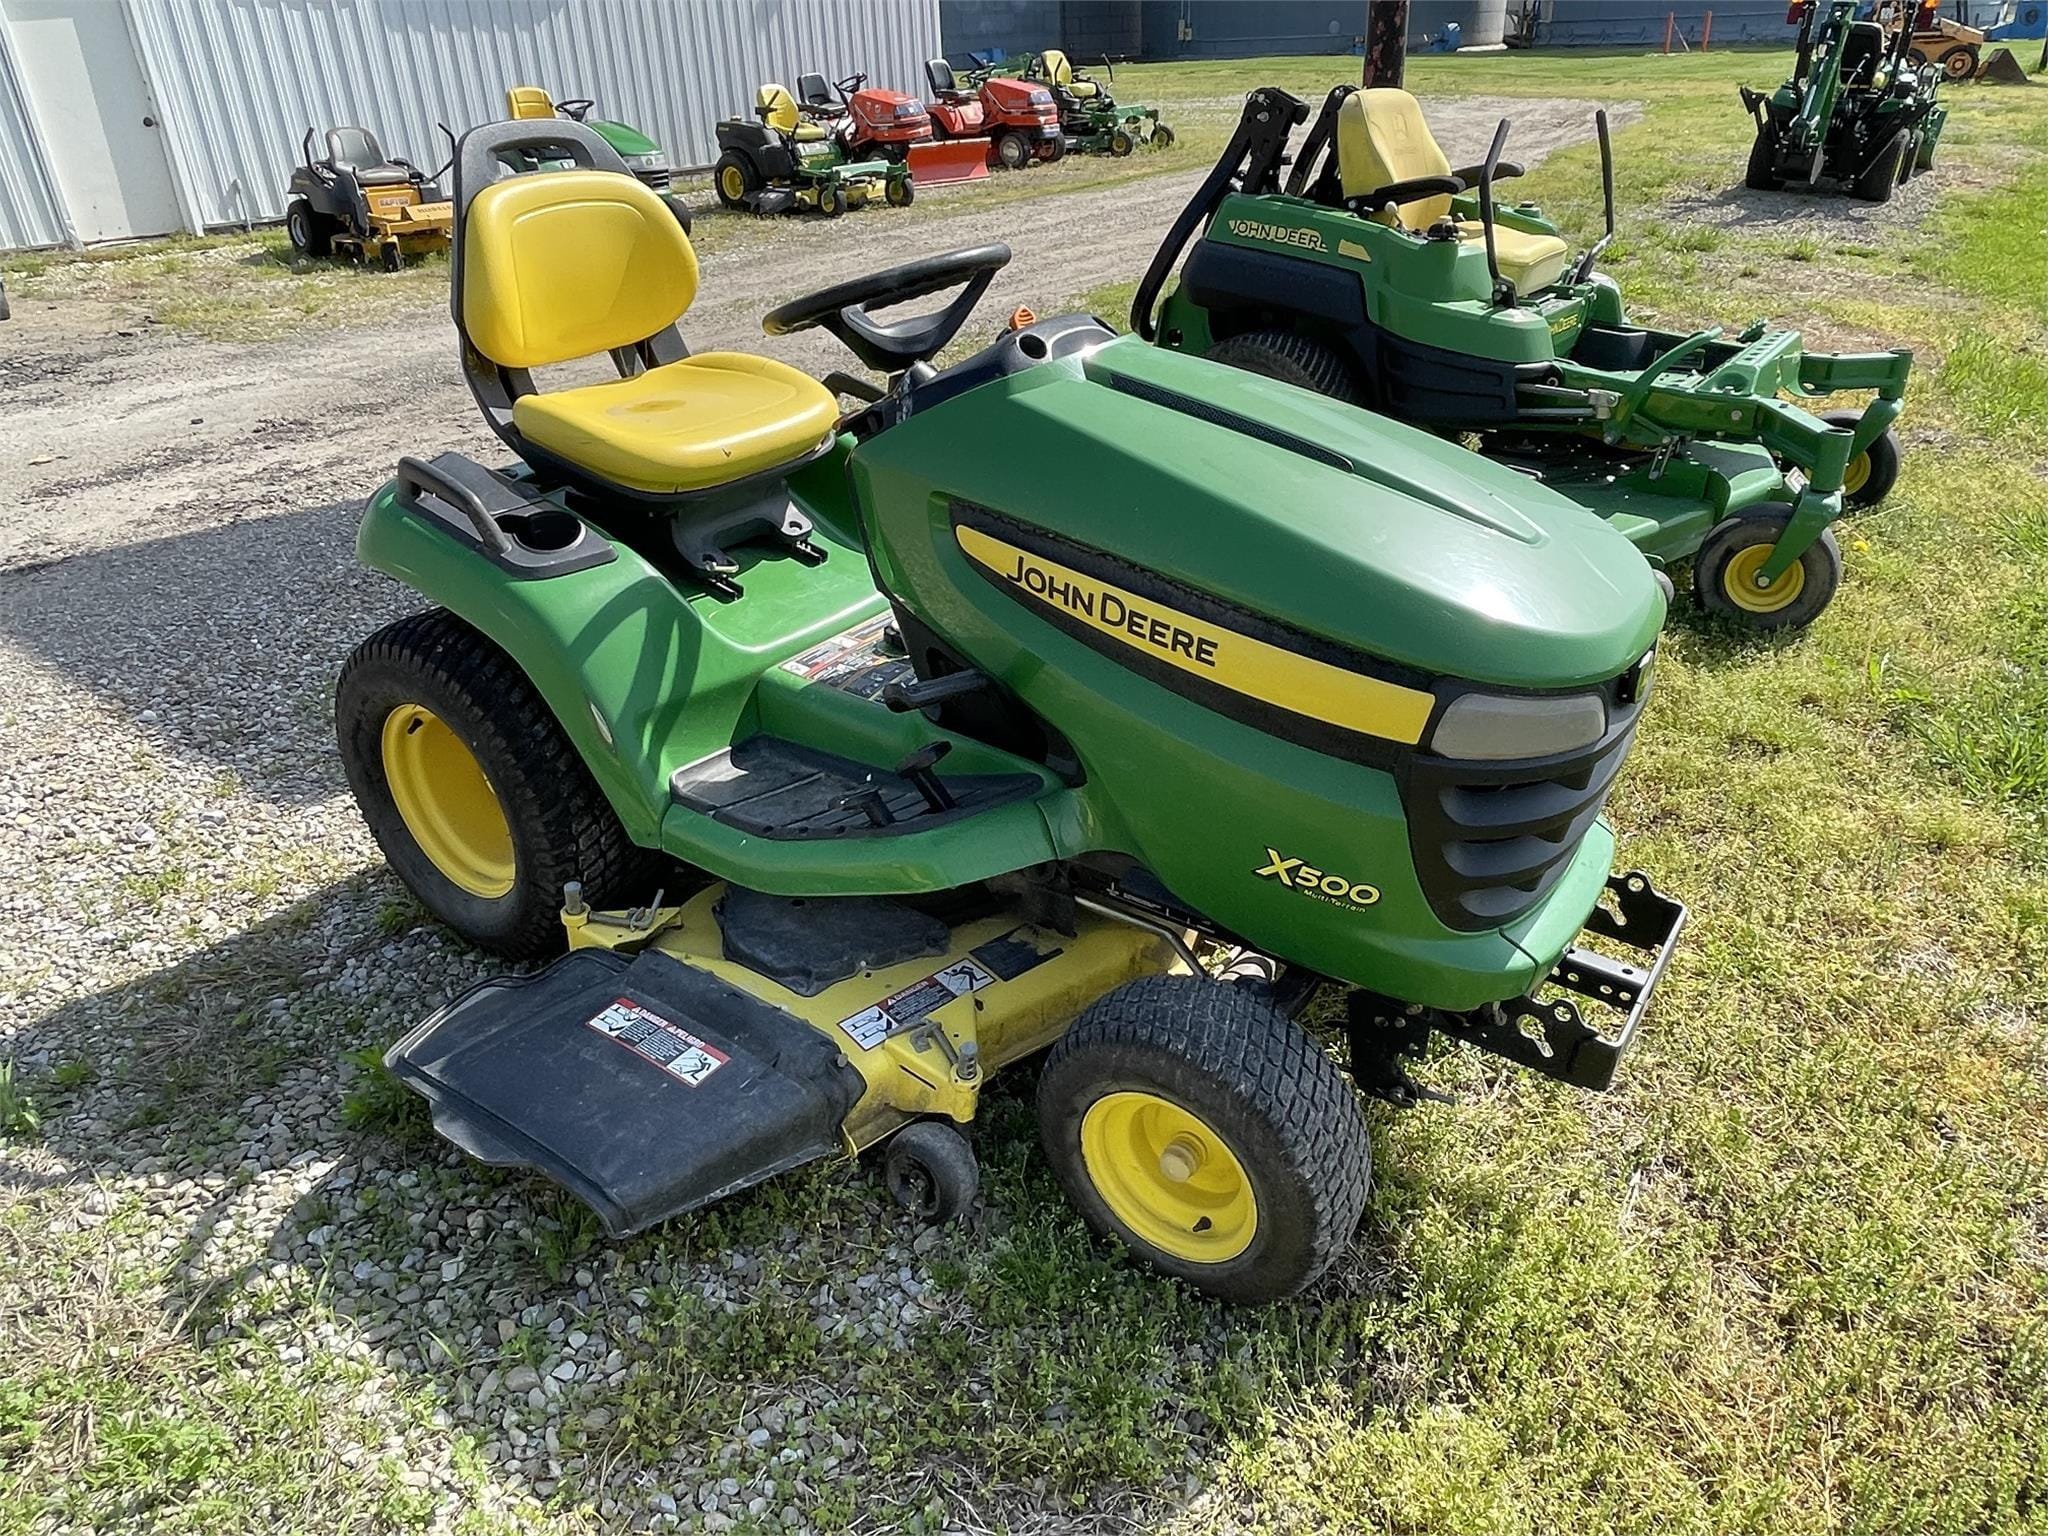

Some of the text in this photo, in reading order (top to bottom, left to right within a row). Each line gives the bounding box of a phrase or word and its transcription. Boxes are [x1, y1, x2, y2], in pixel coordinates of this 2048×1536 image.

[1231, 220, 1271, 238] JOHN
[1006, 555, 1219, 668] JOHN DEERE
[1254, 847, 1381, 905] X500
[894, 981, 930, 1001] DANGER
